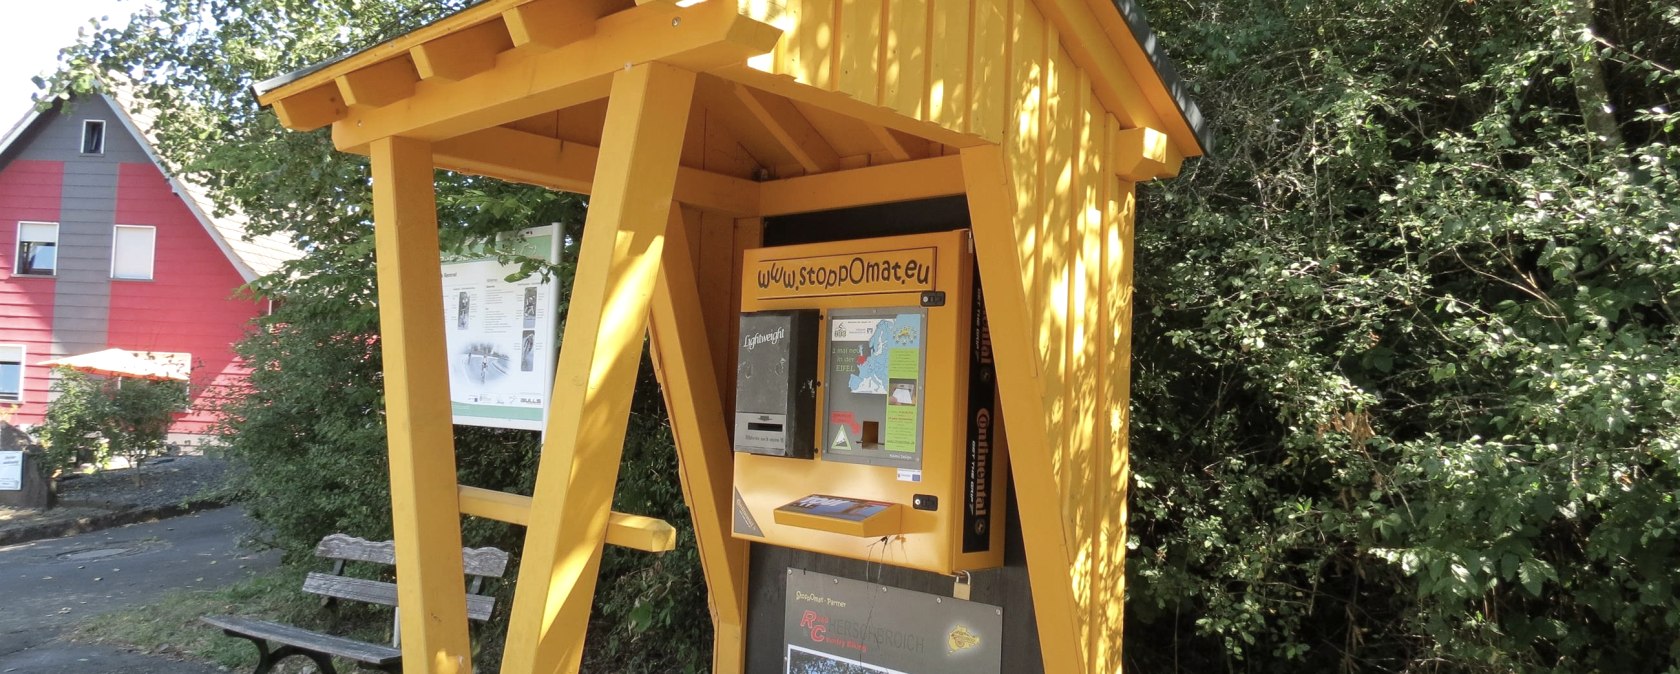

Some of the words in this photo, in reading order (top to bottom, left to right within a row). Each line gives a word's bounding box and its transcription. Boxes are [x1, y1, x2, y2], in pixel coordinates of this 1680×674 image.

[757, 257, 930, 291] www.stoppOmat.eu
[743, 326, 785, 350] Lightweight
[975, 407, 990, 516] Continental
